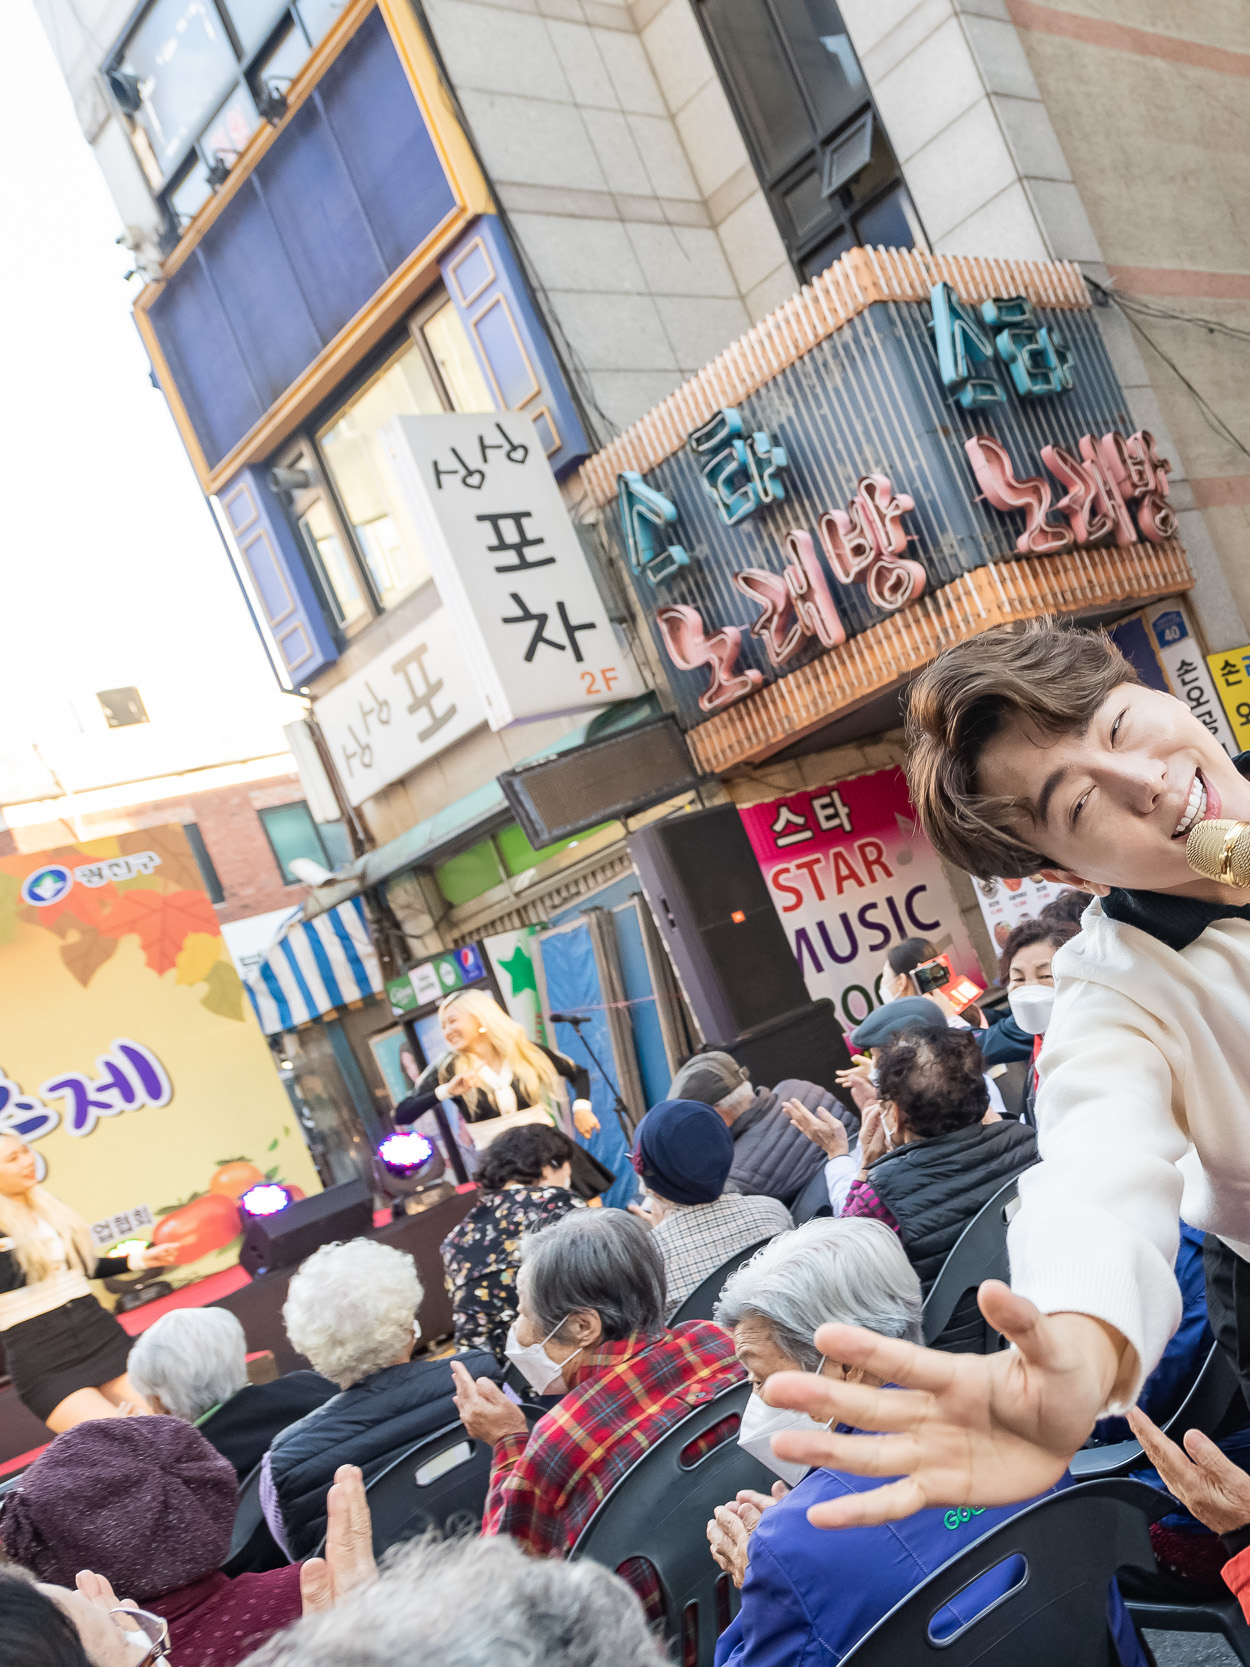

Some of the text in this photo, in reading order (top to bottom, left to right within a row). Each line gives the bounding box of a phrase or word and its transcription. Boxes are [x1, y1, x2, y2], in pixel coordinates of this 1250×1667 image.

[930, 281, 1075, 408] 스타
[432, 422, 529, 490] 상상
[617, 407, 789, 586] 스타
[964, 430, 1179, 552] 노래방
[657, 473, 927, 712] 노래방
[1164, 625, 1181, 641] 40
[580, 667, 619, 695] 2F
[770, 789, 854, 849] 스타
[769, 838, 895, 913] STAR
[794, 884, 941, 979] MUSIC
